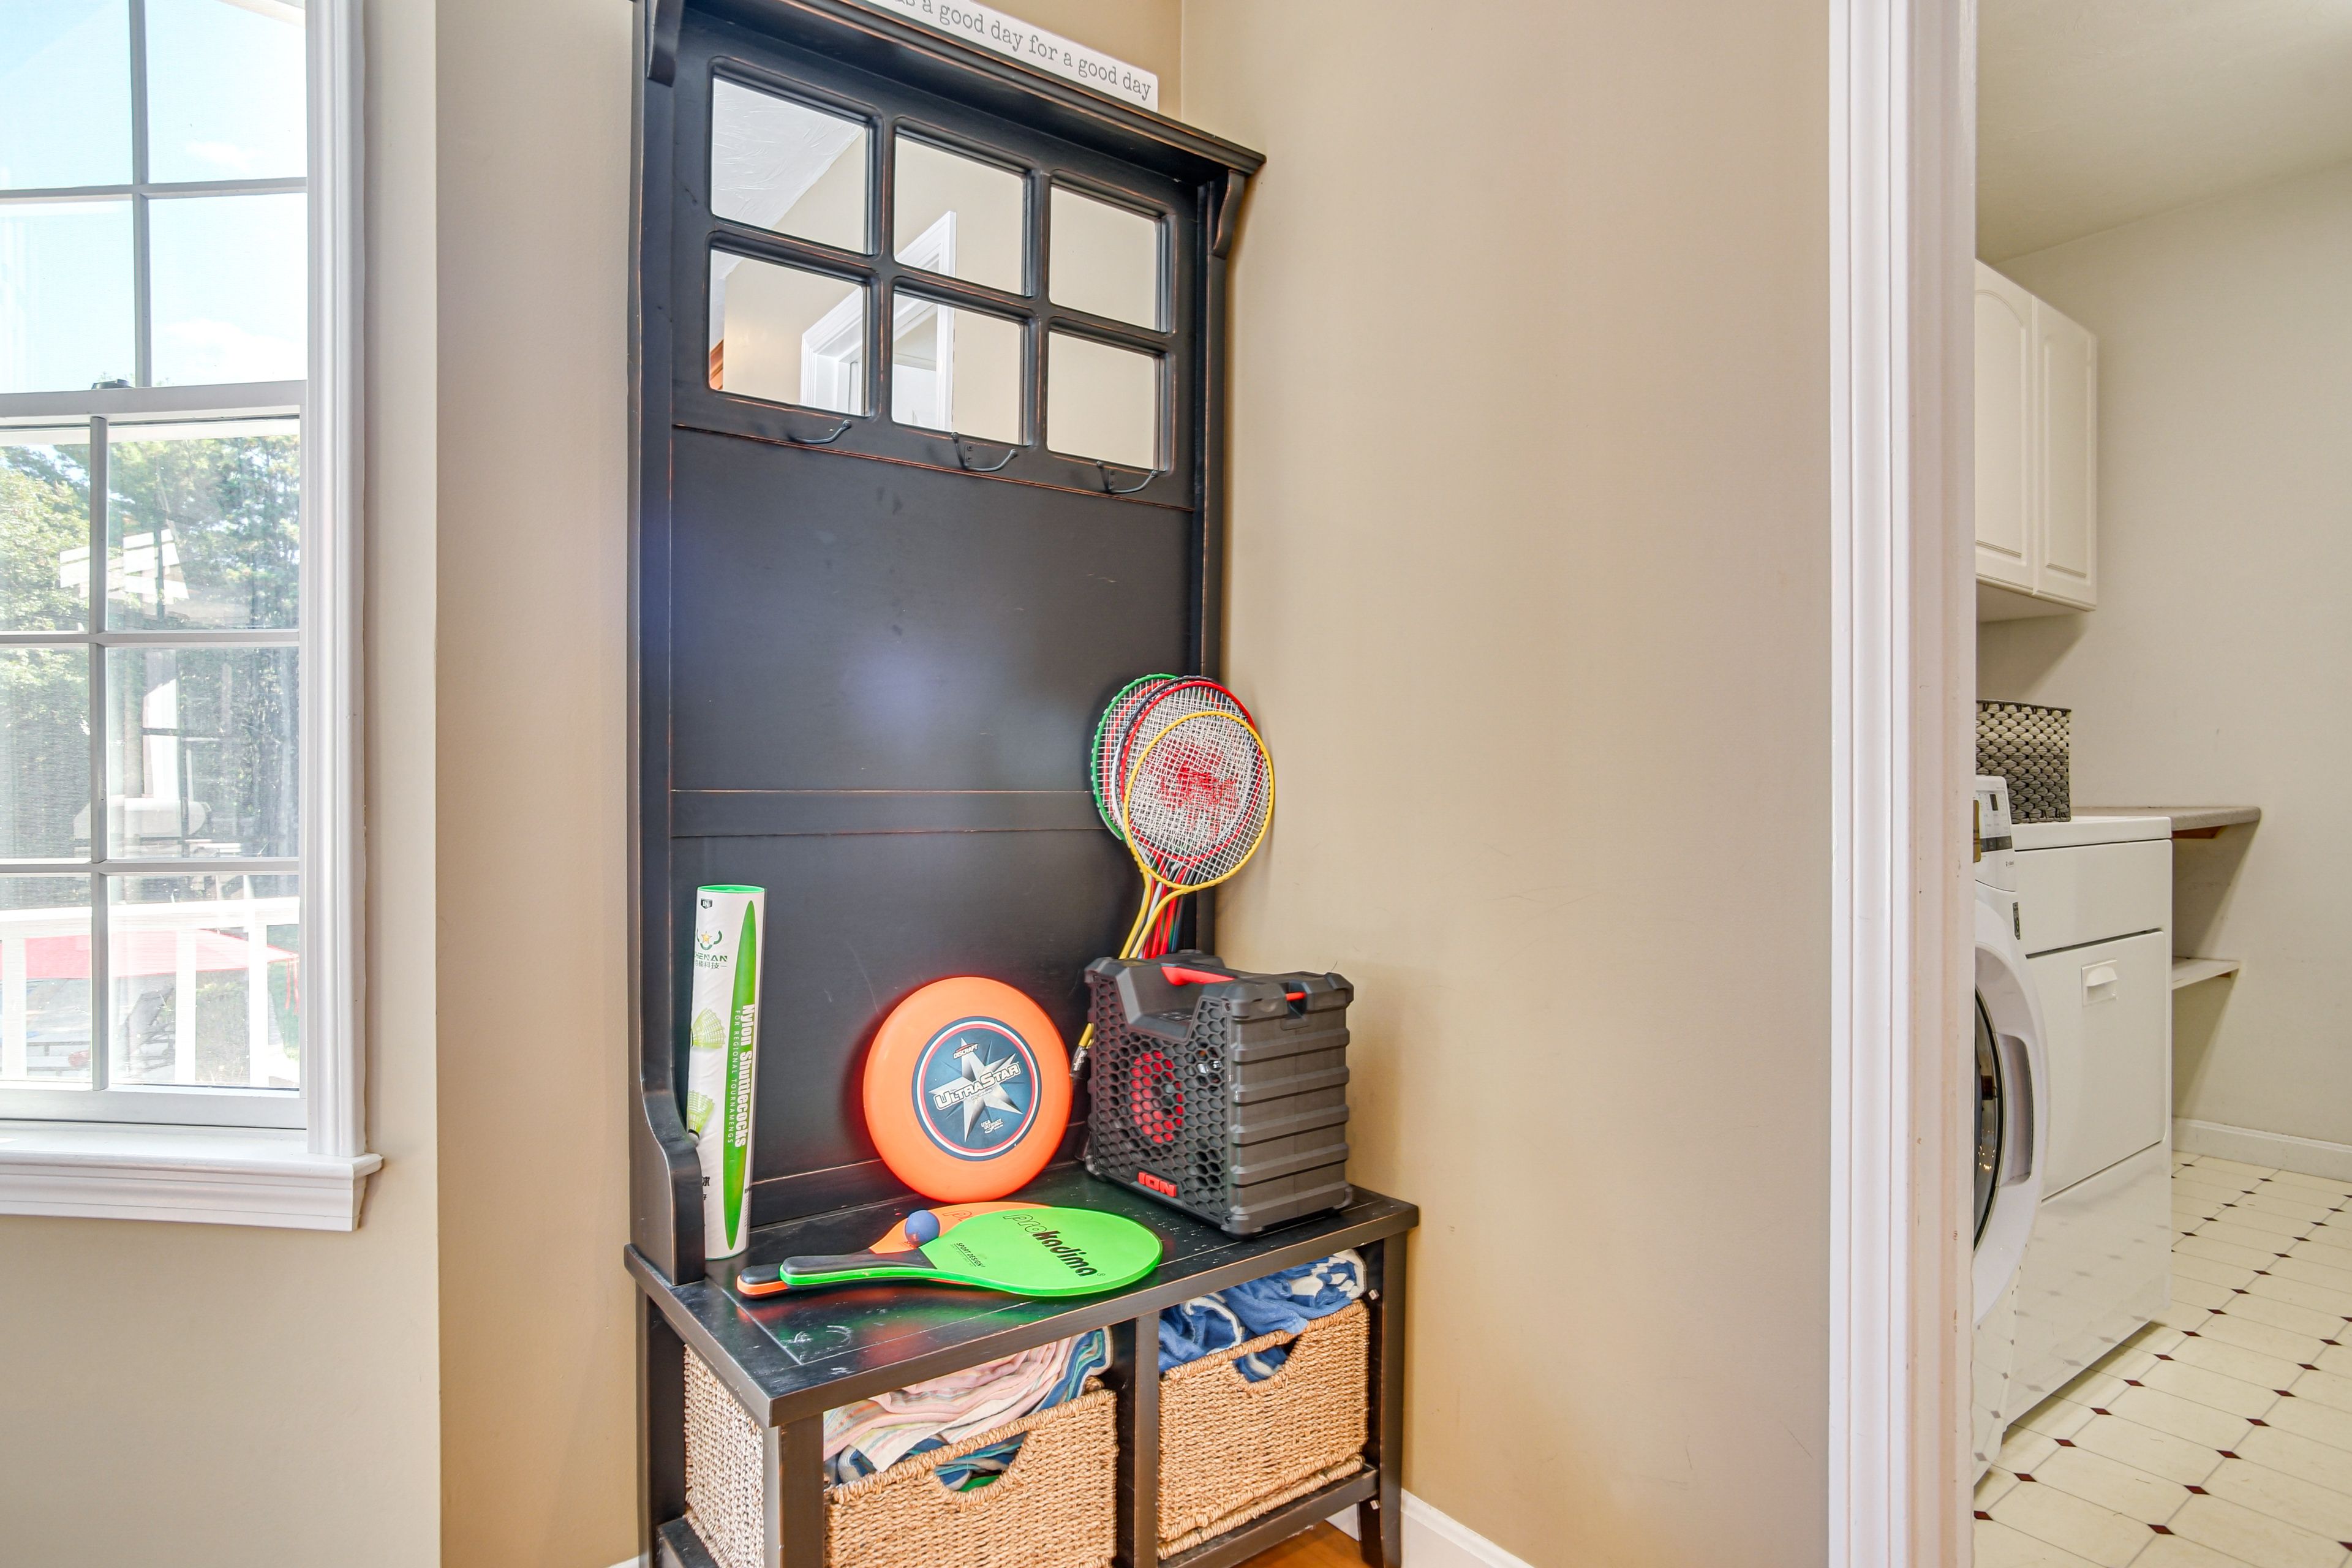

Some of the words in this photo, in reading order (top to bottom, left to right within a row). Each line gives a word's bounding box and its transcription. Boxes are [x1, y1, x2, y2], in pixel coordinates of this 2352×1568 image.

[923, 0, 933, 13] a
[940, 5, 984, 34] good
[991, 20, 1023, 52] day
[1028, 35, 1058, 61] for
[1063, 52, 1073, 67] a
[1078, 58, 1118, 85] good
[1123, 72, 1152, 101] day
[695, 951, 728, 962] HENAN
[741, 1004, 755, 1046] Nylon
[953, 1044, 978, 1059] DISCRAFT
[735, 1050, 752, 1147] Shuttlecocks
[1137, 1170, 1177, 1197] ION
[956, 1243, 971, 1253] SPORT
